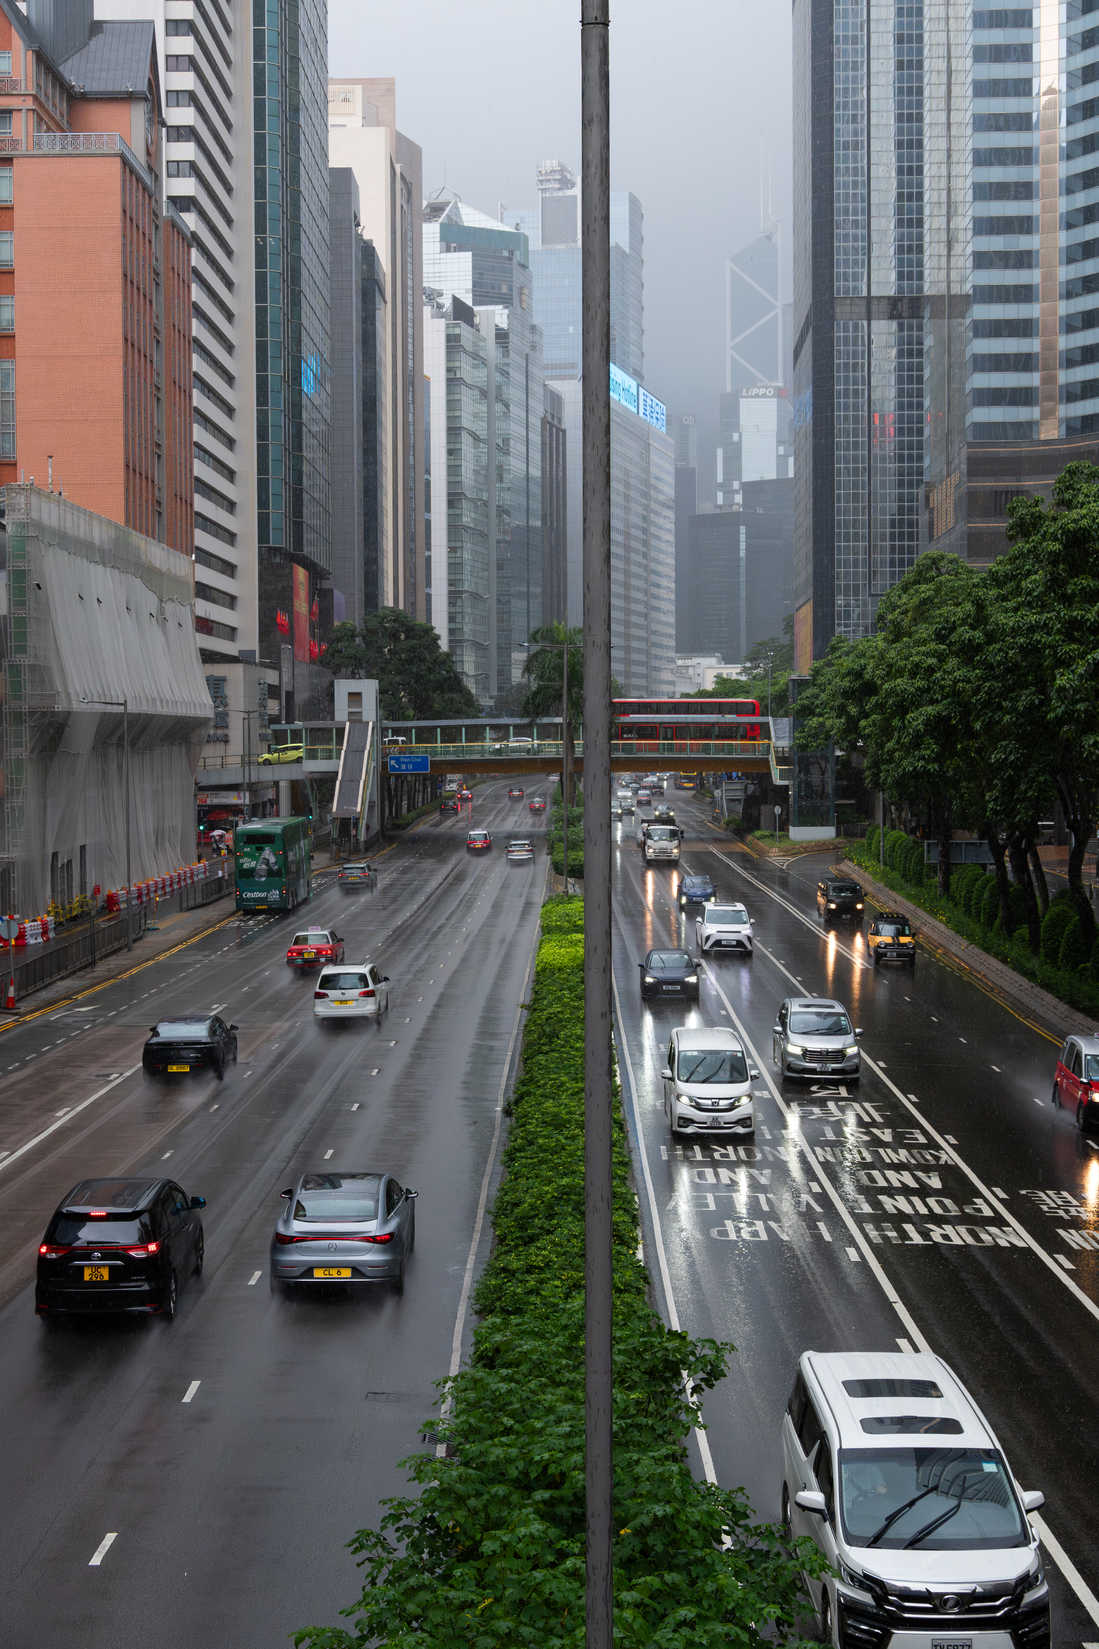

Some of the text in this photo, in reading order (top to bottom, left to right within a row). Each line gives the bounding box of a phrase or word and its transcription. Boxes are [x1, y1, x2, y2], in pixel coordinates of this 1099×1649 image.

[820, 1127, 928, 1144] EAST
[660, 1145, 789, 1161] NORTH
[691, 1168, 772, 1185] AND
[861, 1169, 943, 1189] AND
[854, 1195, 995, 1217] POINT
[862, 1222, 1029, 1248] NORTH
